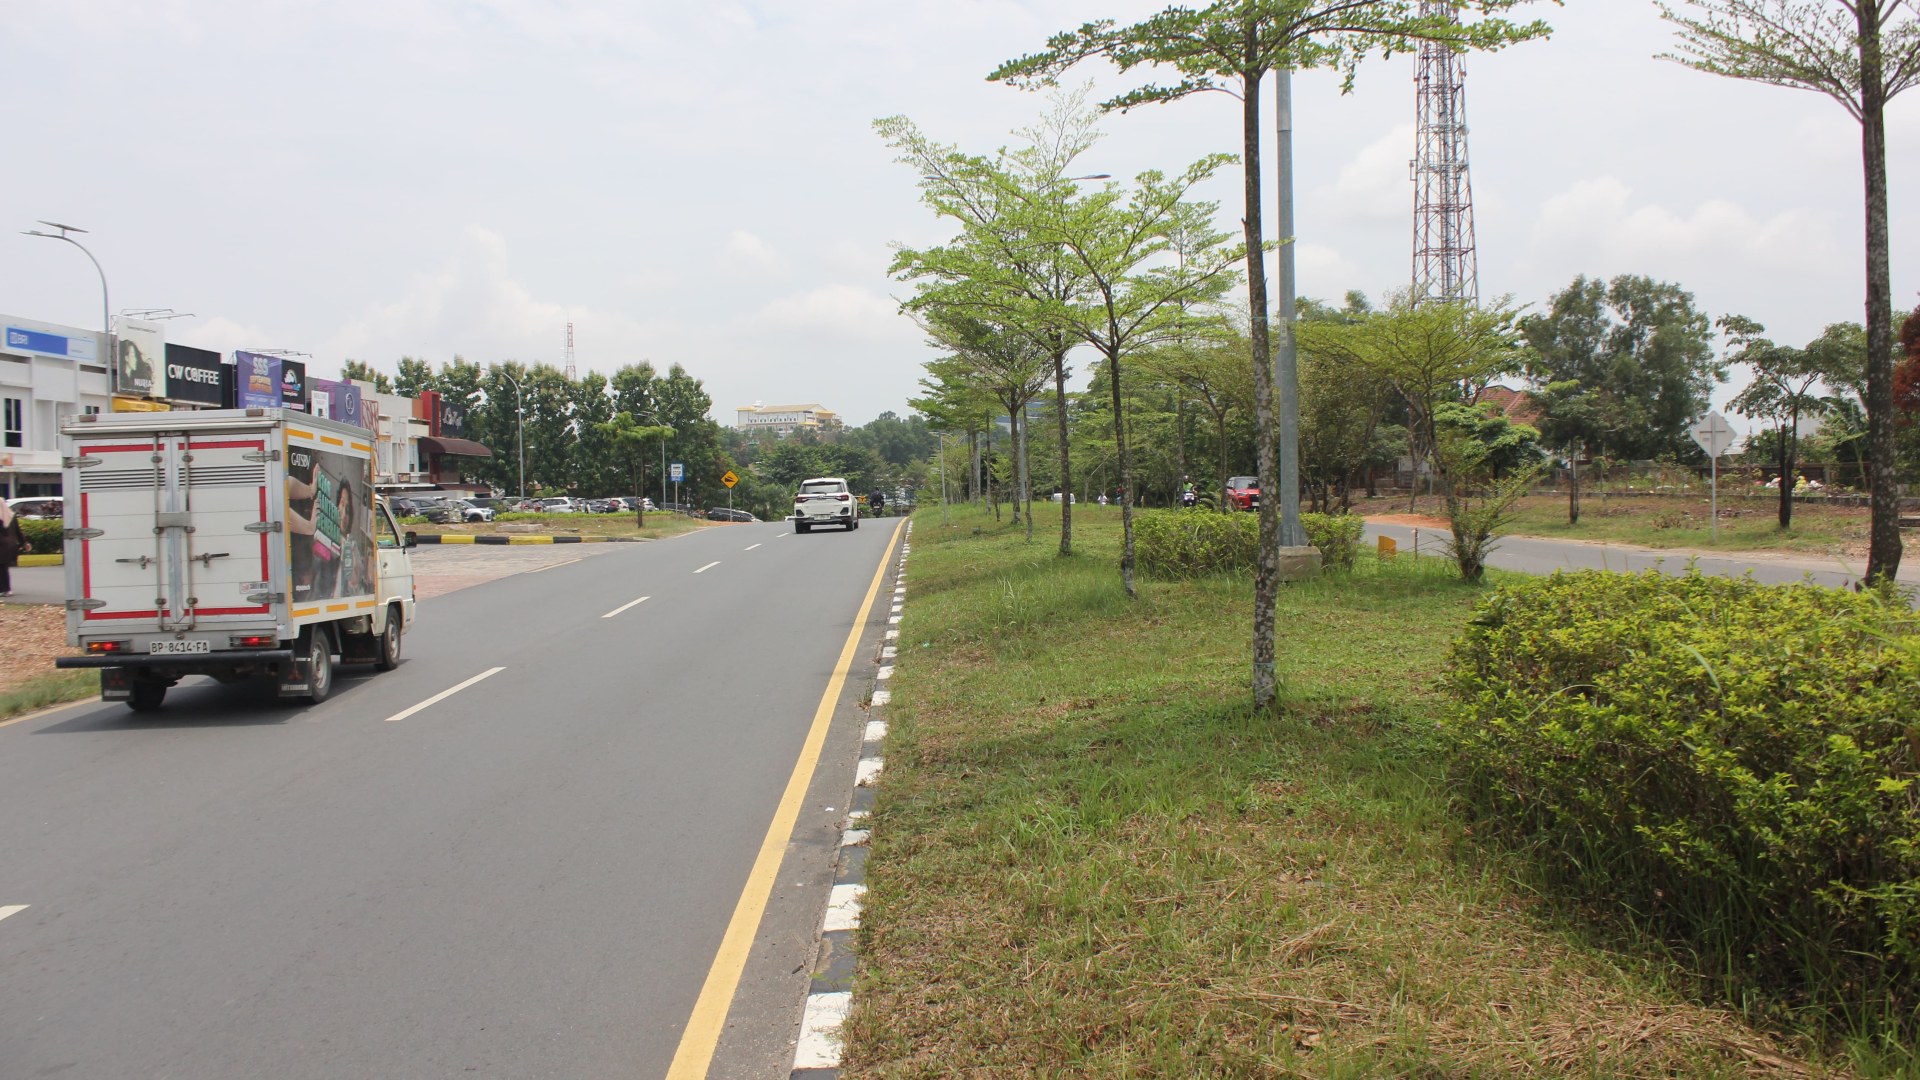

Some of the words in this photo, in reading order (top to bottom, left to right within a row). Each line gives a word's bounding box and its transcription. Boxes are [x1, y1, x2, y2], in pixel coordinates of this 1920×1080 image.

[168, 364, 184, 379] CW
[291, 452, 311, 470] GATSBY
[151, 642, 163, 652] BP
[168, 642, 192, 652] 8414
[196, 642, 208, 652] FA
